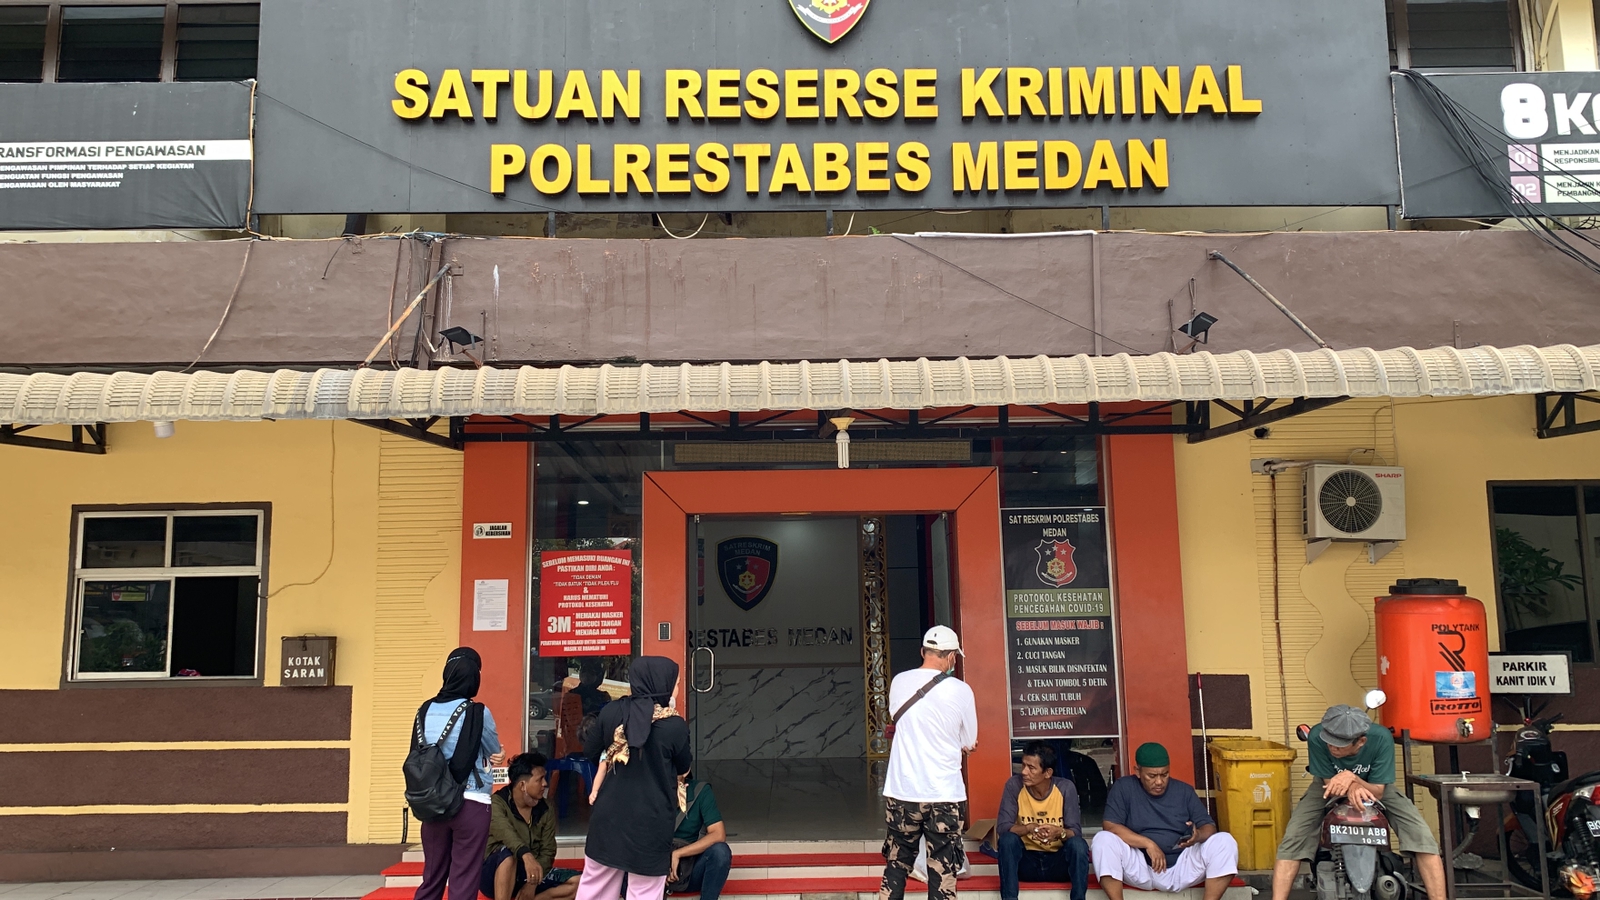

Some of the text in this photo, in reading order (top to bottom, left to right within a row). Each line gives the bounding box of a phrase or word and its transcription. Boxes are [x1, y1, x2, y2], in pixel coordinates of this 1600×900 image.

[391, 65, 1262, 119] SATUAN RESERSE KRIMINAL
[1501, 83, 1549, 139] 8
[105, 145, 206, 157] PENGAWASAN
[490, 138, 1170, 194] POLRESTABES MEDAN
[1009, 514, 1100, 524] SAT RESKRIM POLRESTABES
[1043, 528, 1067, 537] MEDAN
[723, 541, 771, 552] SATRESKRIM
[542, 556, 566, 568] SEBELUM
[1014, 593, 1103, 602] PROTOKOL KESEHATAN
[1014, 603, 1104, 613] PENCEGAHAN COVID-19
[547, 616, 571, 633] 3M
[1016, 620, 1049, 631] SEBELUM
[1050, 620, 1076, 630] MASUK
[1077, 620, 1099, 629] WAJIB
[1431, 623, 1480, 632] POLYTANK
[788, 626, 853, 647] MEDAN
[1016, 637, 1080, 646] 1. GUNAKAN MASKER
[288, 655, 321, 666] KOTAK
[1017, 651, 1066, 660] 2. CUCI TANGAN
[1018, 664, 1107, 674] 3. MASUK BILIK DISINFEKTAN
[1502, 661, 1548, 672] PARKIR
[284, 668, 324, 678] SARAN
[1027, 678, 1108, 688] & TEKAN TOMBOL 5 DETIK
[1496, 675, 1556, 686] KANIT IDIK V
[1019, 692, 1082, 702] 4. CEK SUHU TUBUH
[453, 702, 467, 717] YOU
[1020, 706, 1087, 716] 5. LAPOR KEPERLUAN
[1434, 702, 1479, 711] ROTTO
[1029, 721, 1073, 730] DI PENJAGAAN
